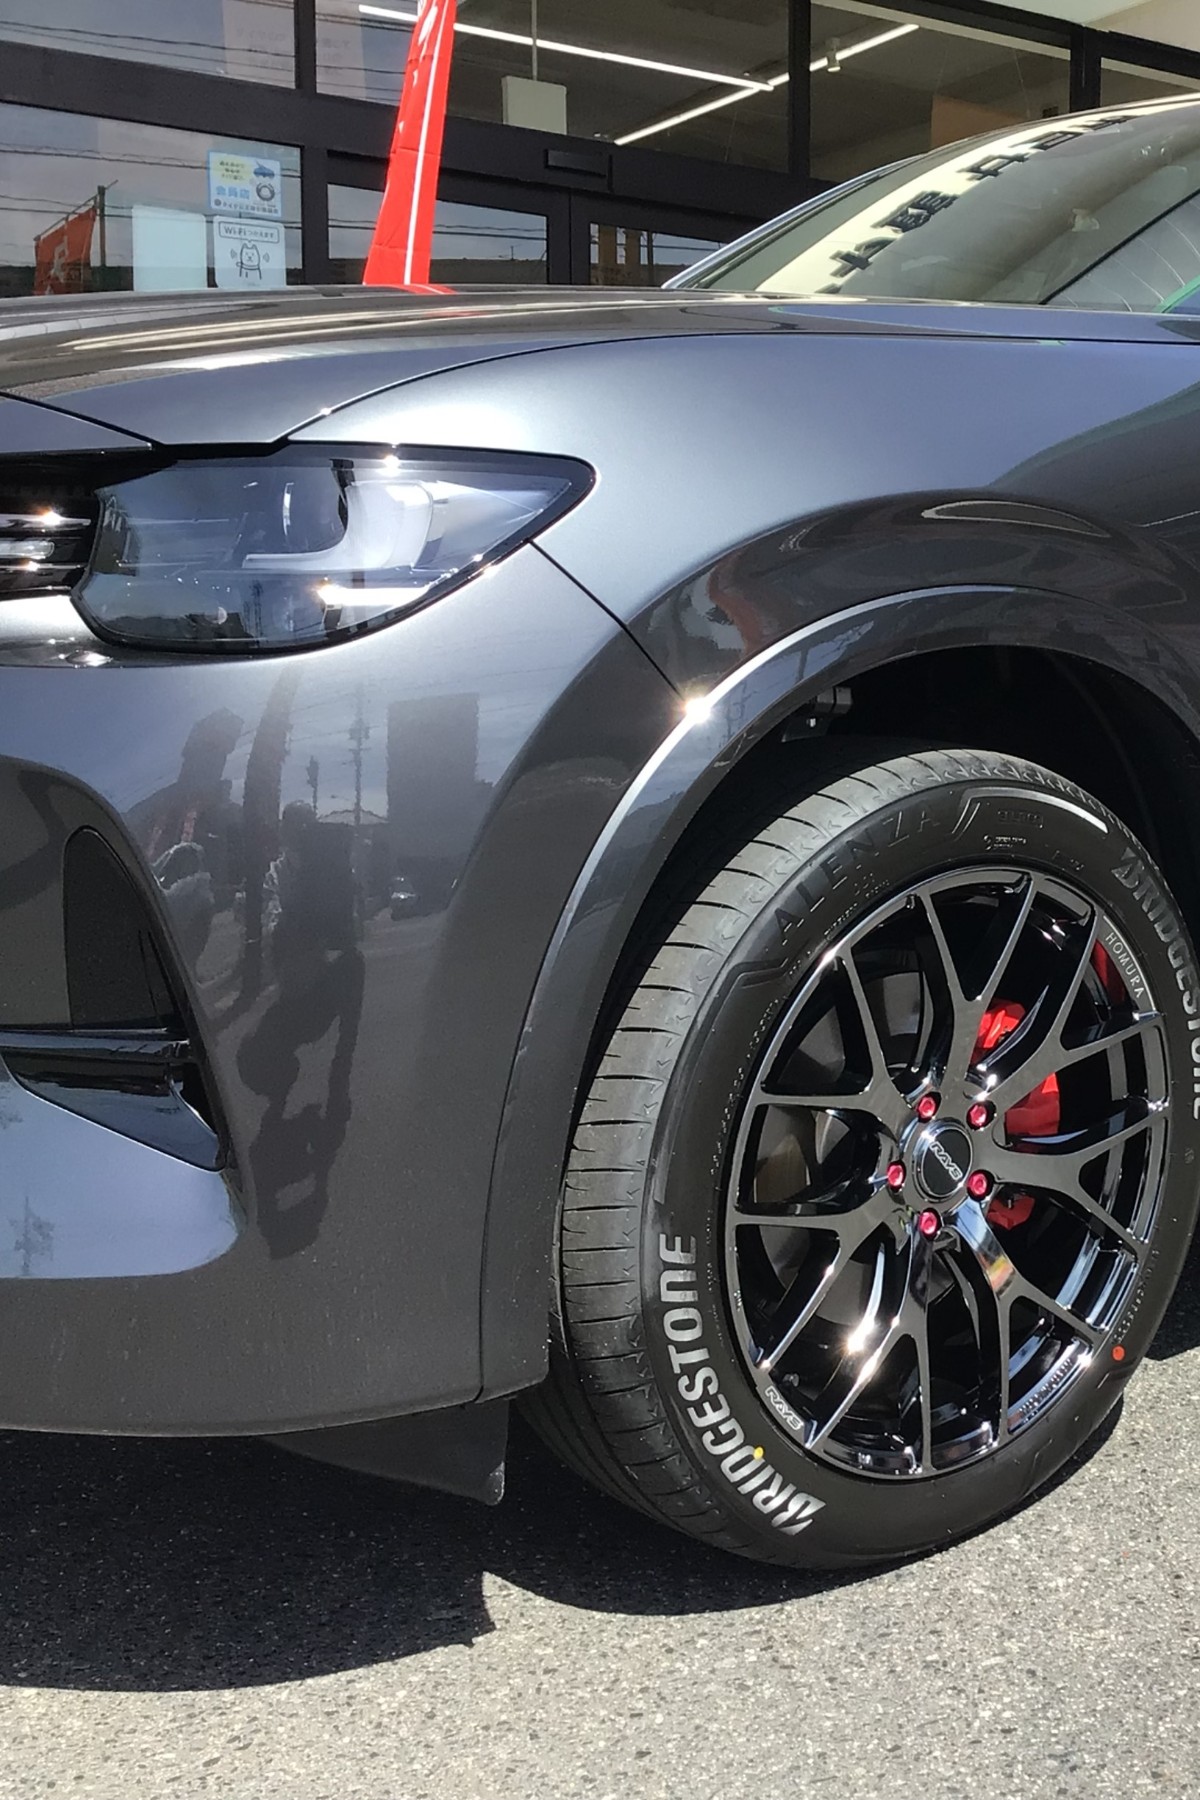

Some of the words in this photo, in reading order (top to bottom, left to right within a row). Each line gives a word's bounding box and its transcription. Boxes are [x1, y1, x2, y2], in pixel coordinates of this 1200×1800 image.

[774, 810, 942, 946] ALENZA
[1105, 932, 1145, 999] HOMURA
[929, 1141, 964, 1181] RAYS
[659, 1233, 827, 1536] BRIDGESTONE
[765, 1385, 805, 1431] RAYS
